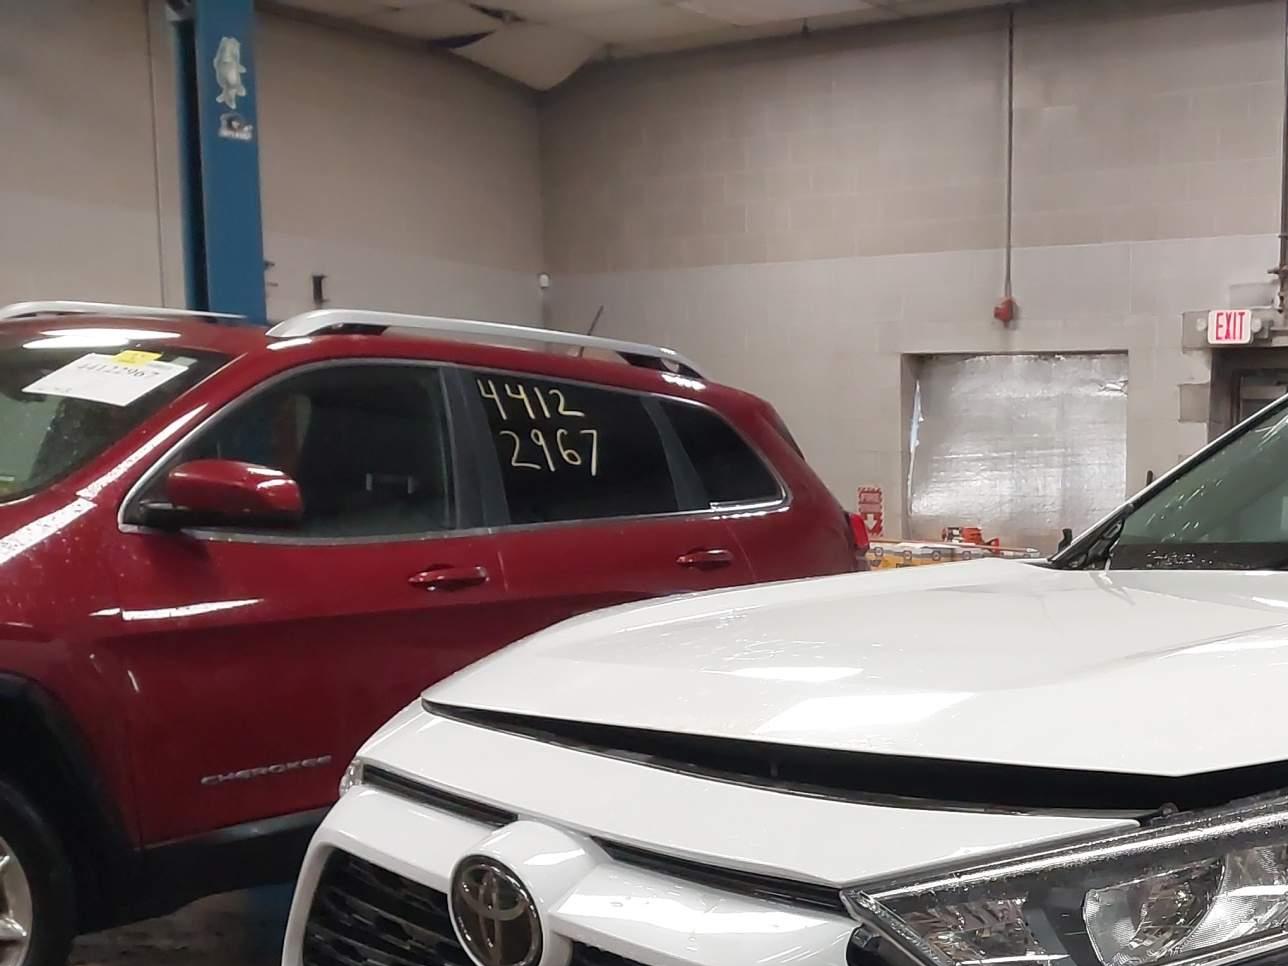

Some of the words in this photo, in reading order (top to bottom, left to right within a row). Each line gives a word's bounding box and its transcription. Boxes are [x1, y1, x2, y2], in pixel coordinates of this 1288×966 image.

[1215, 311, 1245, 340] EXIT
[477, 379, 585, 420] 4412
[499, 428, 597, 476] 2967
